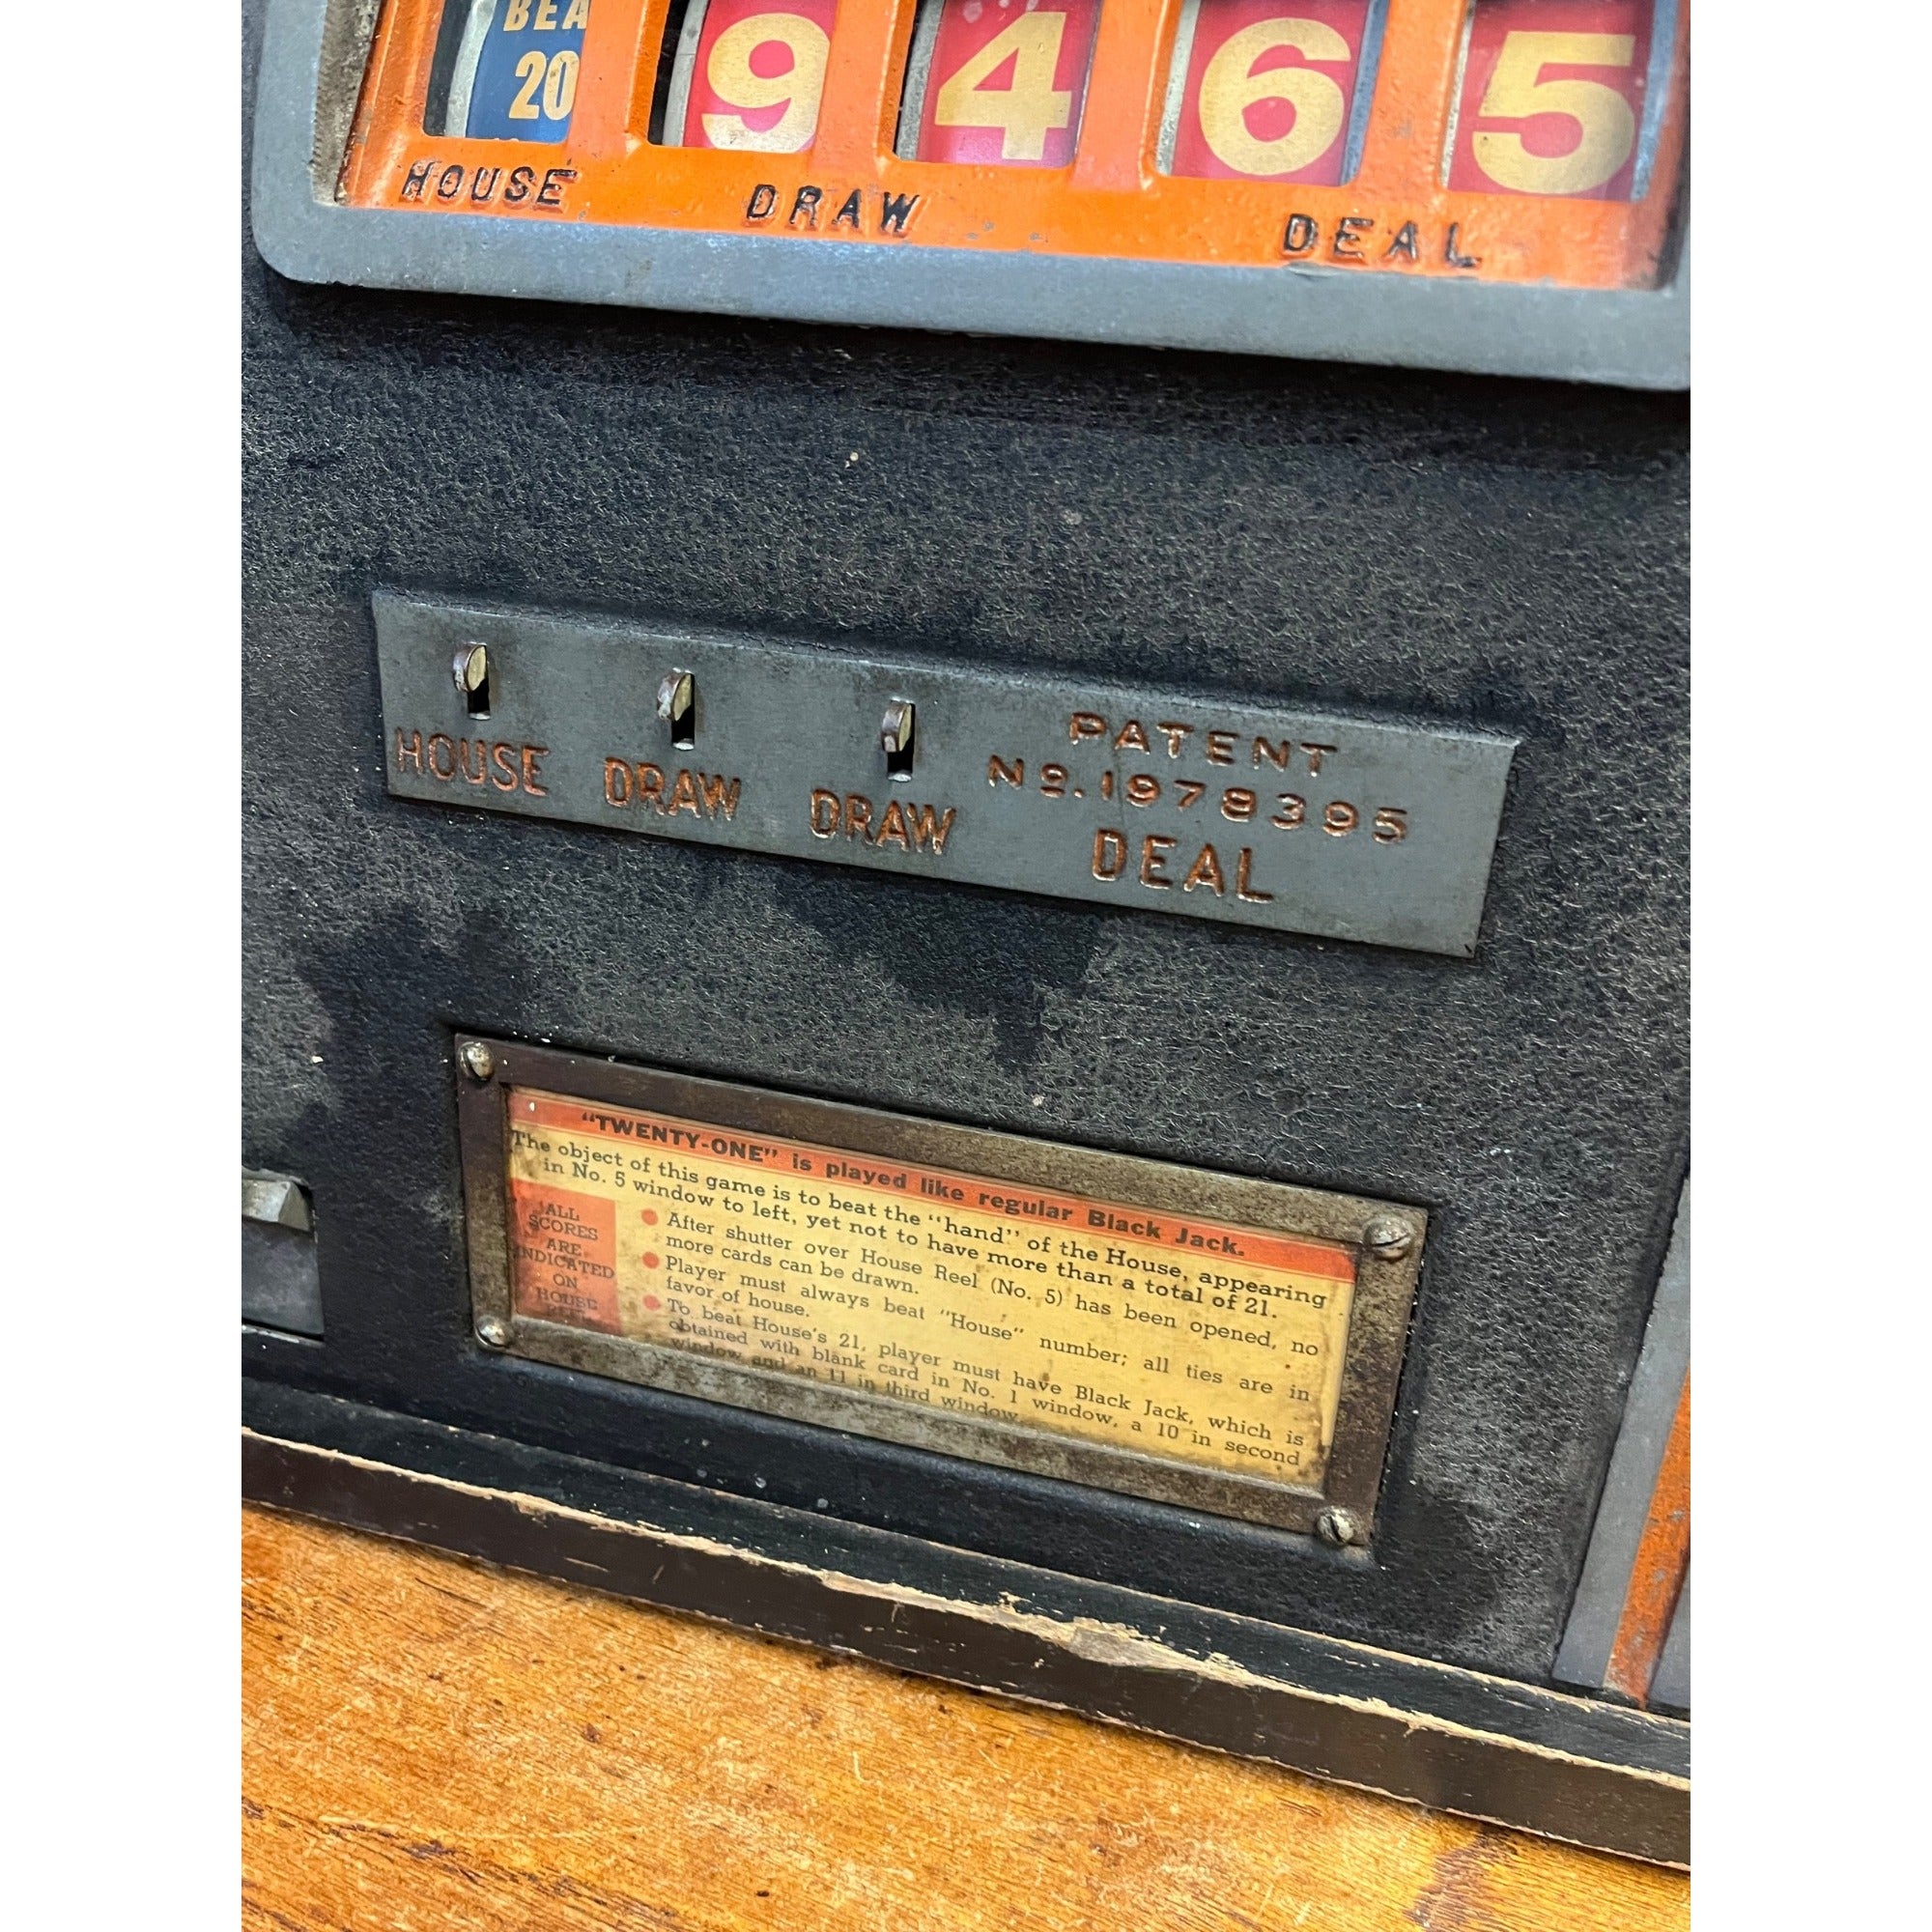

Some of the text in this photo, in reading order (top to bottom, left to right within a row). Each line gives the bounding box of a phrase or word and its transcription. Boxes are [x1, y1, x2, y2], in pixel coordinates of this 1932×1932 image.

[508, 50, 580, 121] 20
[701, 13, 831, 154] 9
[933, 10, 1071, 160] 4
[1198, 17, 1352, 176] 6
[1471, 31, 1636, 194] 5
[401, 160, 579, 210] HOUSE
[745, 184, 921, 236] DRAW
[1281, 212, 1482, 269] DEAL
[393, 725, 550, 797] HOUSE
[1068, 711, 1339, 777] PATENT
[603, 755, 742, 821] DRAW
[809, 788, 956, 855] DRAW
[1092, 828, 1274, 904] DEAL
[546, 1204, 580, 1221] ALL
[582, 1112, 1245, 1257] "TWENTY-ONE" is played like regular Black Jack.
[512, 1129, 1327, 1309] The object of this game is to beat the "hand" of the House, appearing
[528, 1214, 599, 1240] SCORES
[544, 1158, 1277, 1320] in No. 5 window to left, yet not to have more than a total of 21.
[547, 1237, 582, 1257] ARE
[518, 1247, 615, 1279] NDICATED
[554, 1273, 578, 1289] ON
[666, 1236, 919, 1294] more cards can be drawn.
[667, 1211, 1319, 1356] After shutter over House Reel (No. 5) has been opened, no
[536, 1287, 598, 1310] HOUSE
[666, 1255, 1310, 1402] Player must always beat "House" number; all ties are in
[667, 1276, 810, 1318] favor of house.
[668, 1297, 691, 1316] To
[702, 1305, 742, 1326] beat
[753, 1315, 827, 1344] House's
[878, 1342, 941, 1366] player
[952, 1359, 1000, 1381] must
[1013, 1371, 1063, 1395] have
[1075, 1384, 1131, 1410] Black
[1144, 1399, 1194, 1425] Jack,
[1208, 1416, 1271, 1440] which
[1286, 1430, 1304, 1446] is
[668, 1319, 1300, 1465] obtained with blank card in No. 1 window, a 10 in second
[670, 1337, 742, 1361] window
[752, 1354, 785, 1370] and
[797, 1363, 816, 1378] an
[858, 1375, 876, 1391] in
[886, 1380, 930, 1403] third
